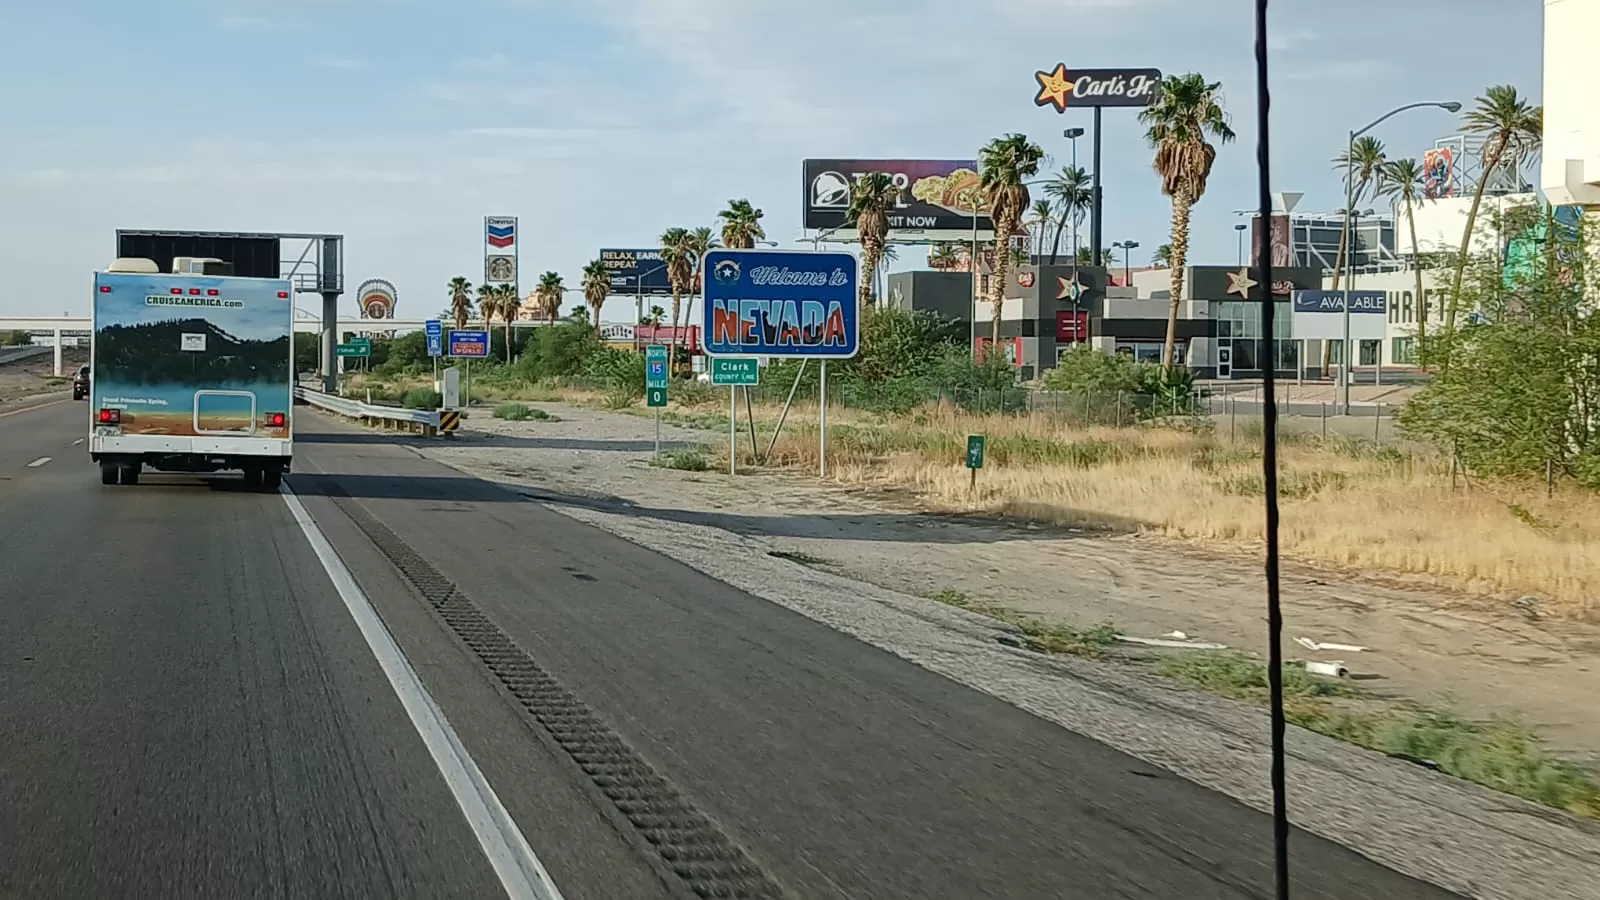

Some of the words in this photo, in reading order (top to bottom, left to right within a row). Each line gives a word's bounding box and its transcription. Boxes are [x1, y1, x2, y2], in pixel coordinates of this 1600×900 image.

[1072, 75, 1126, 99] Carl's
[1126, 75, 1155, 98] Jr.
[906, 216, 937, 227] NOW
[602, 251, 634, 261] RELAX.
[750, 266, 828, 287] Welcome
[829, 268, 849, 287] to
[146, 296, 243, 308] CRUISEAMERICA.com
[712, 299, 848, 347] NEVADA
[647, 350, 667, 358] NORTH
[651, 363, 662, 374] 15
[720, 362, 750, 371] Clark
[714, 373, 739, 381] COUNTY
[648, 379, 667, 389] MILE
[653, 391, 661, 402] 0
